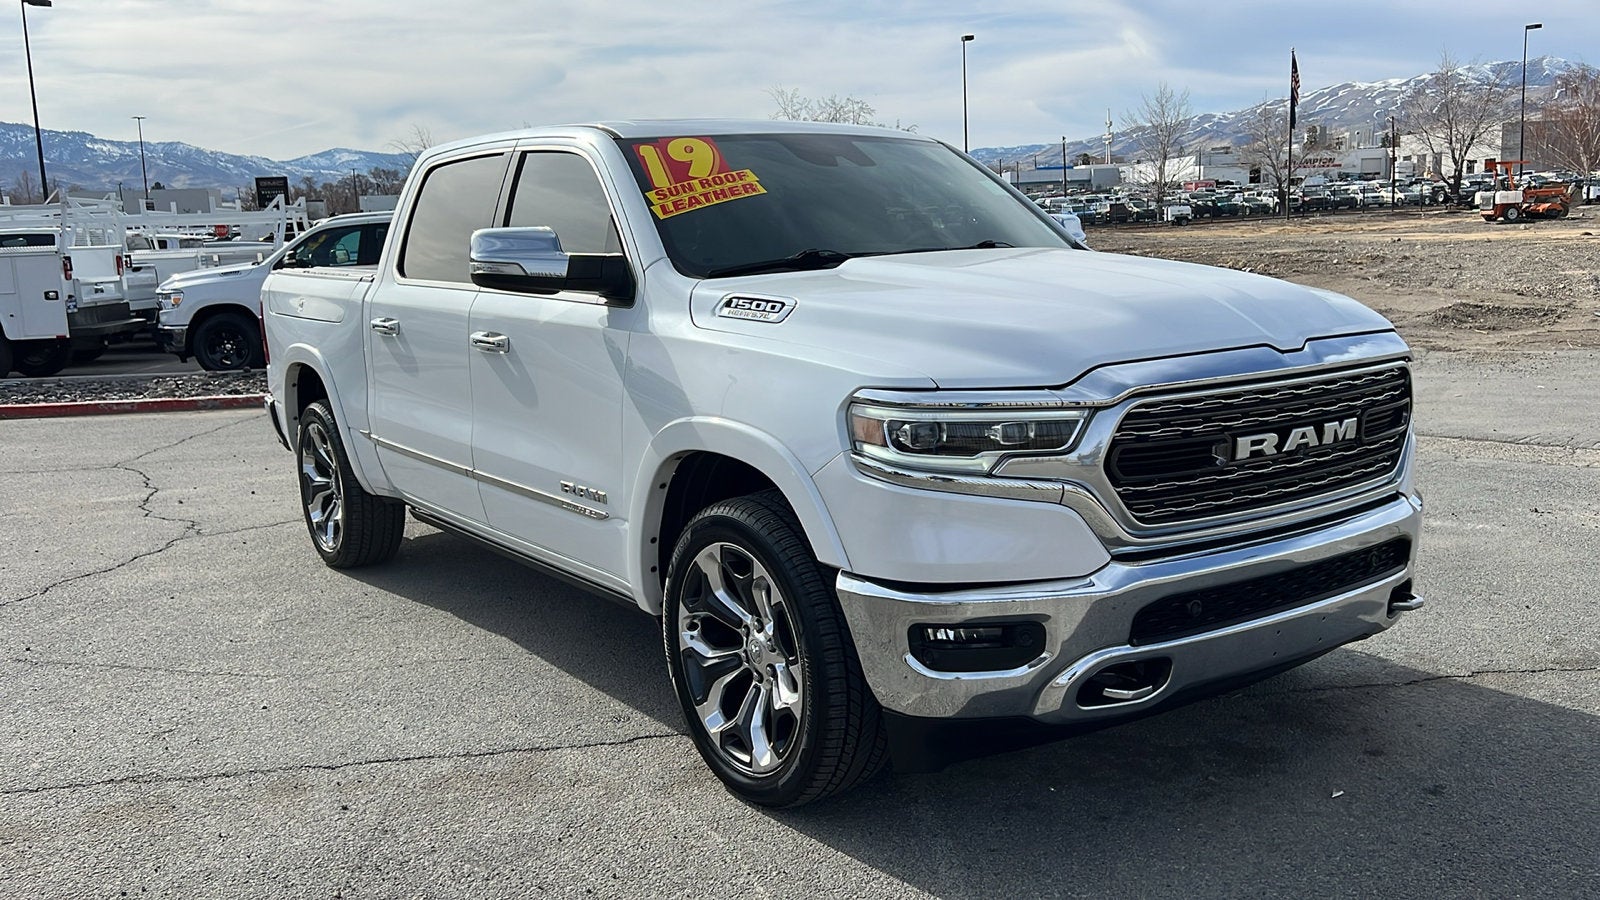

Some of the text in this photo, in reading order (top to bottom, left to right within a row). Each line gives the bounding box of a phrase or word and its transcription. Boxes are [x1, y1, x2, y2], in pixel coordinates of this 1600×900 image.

[638, 137, 714, 188] 19
[654, 171, 748, 201] SUN ROOF
[659, 183, 759, 216] LEATHER
[730, 298, 782, 312] 1500
[1235, 418, 1358, 460] RAM
